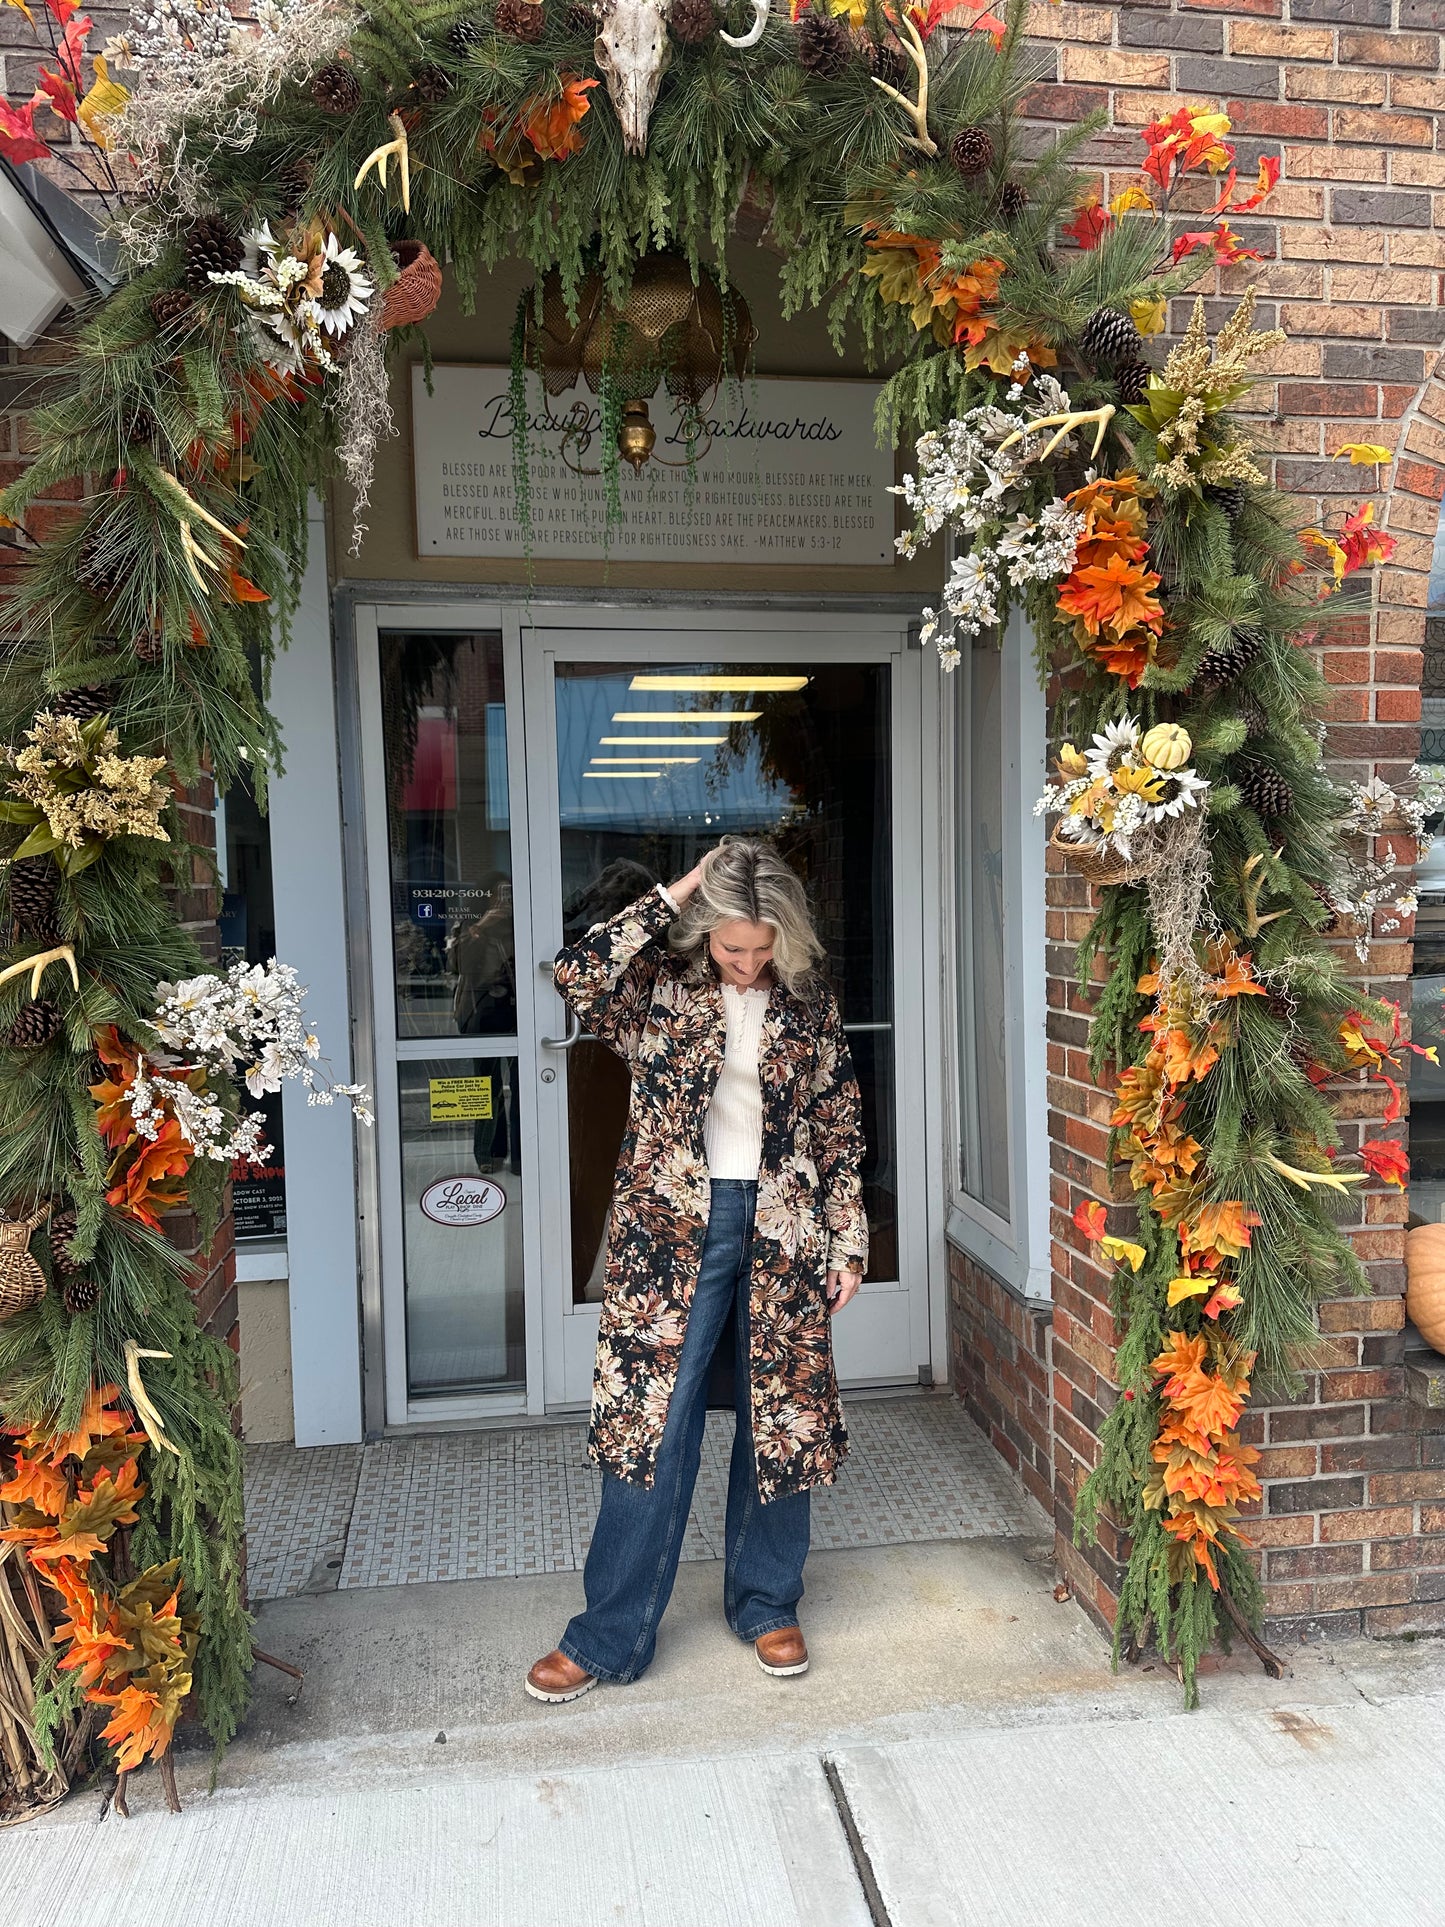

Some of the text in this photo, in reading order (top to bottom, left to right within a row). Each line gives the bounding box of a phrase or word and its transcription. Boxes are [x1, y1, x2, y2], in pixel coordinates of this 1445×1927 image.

[442, 462, 485, 476] BLESSED
[490, 464, 507, 477] ARE
[531, 465, 556, 479] POOR
[560, 466, 567, 479] IN
[650, 469, 666, 482] ARE
[702, 471, 724, 484] WHO
[766, 472, 806, 486] BLESSED
[809, 473, 826, 486] ARE
[830, 474, 844, 487] THE
[848, 474, 875, 488] MEEK.
[443, 484, 489, 498] BLESSED
[493, 485, 512, 499] ARE
[552, 488, 577, 500] WHO
[623, 490, 643, 502] AND
[647, 490, 679, 504] THIRST
[684, 491, 701, 504] FOR
[789, 494, 831, 507] BLESSED
[834, 495, 852, 508] ARE
[855, 495, 872, 508] THE
[444, 505, 497, 520] MERCIFUL.
[548, 508, 566, 522] ARE
[571, 509, 587, 523] THE
[632, 511, 666, 525] HEART.
[668, 511, 711, 526] BLESSED
[715, 513, 733, 526] ARE
[738, 513, 753, 527] THE
[757, 514, 830, 528] PEACEMAKERS.
[833, 515, 875, 529] BLESSED
[447, 527, 464, 540] ARE
[469, 528, 500, 541] THOSE
[504, 529, 526, 542] WHO
[530, 530, 549, 543] ARE
[619, 532, 636, 544] FOR
[640, 532, 716, 546] RIGHTEOUSNESS
[720, 534, 748, 547] SAKE.
[754, 535, 806, 548] -MATTHEW
[811, 536, 841, 549] 5:3-12
[436, 1182, 489, 1212] Local
